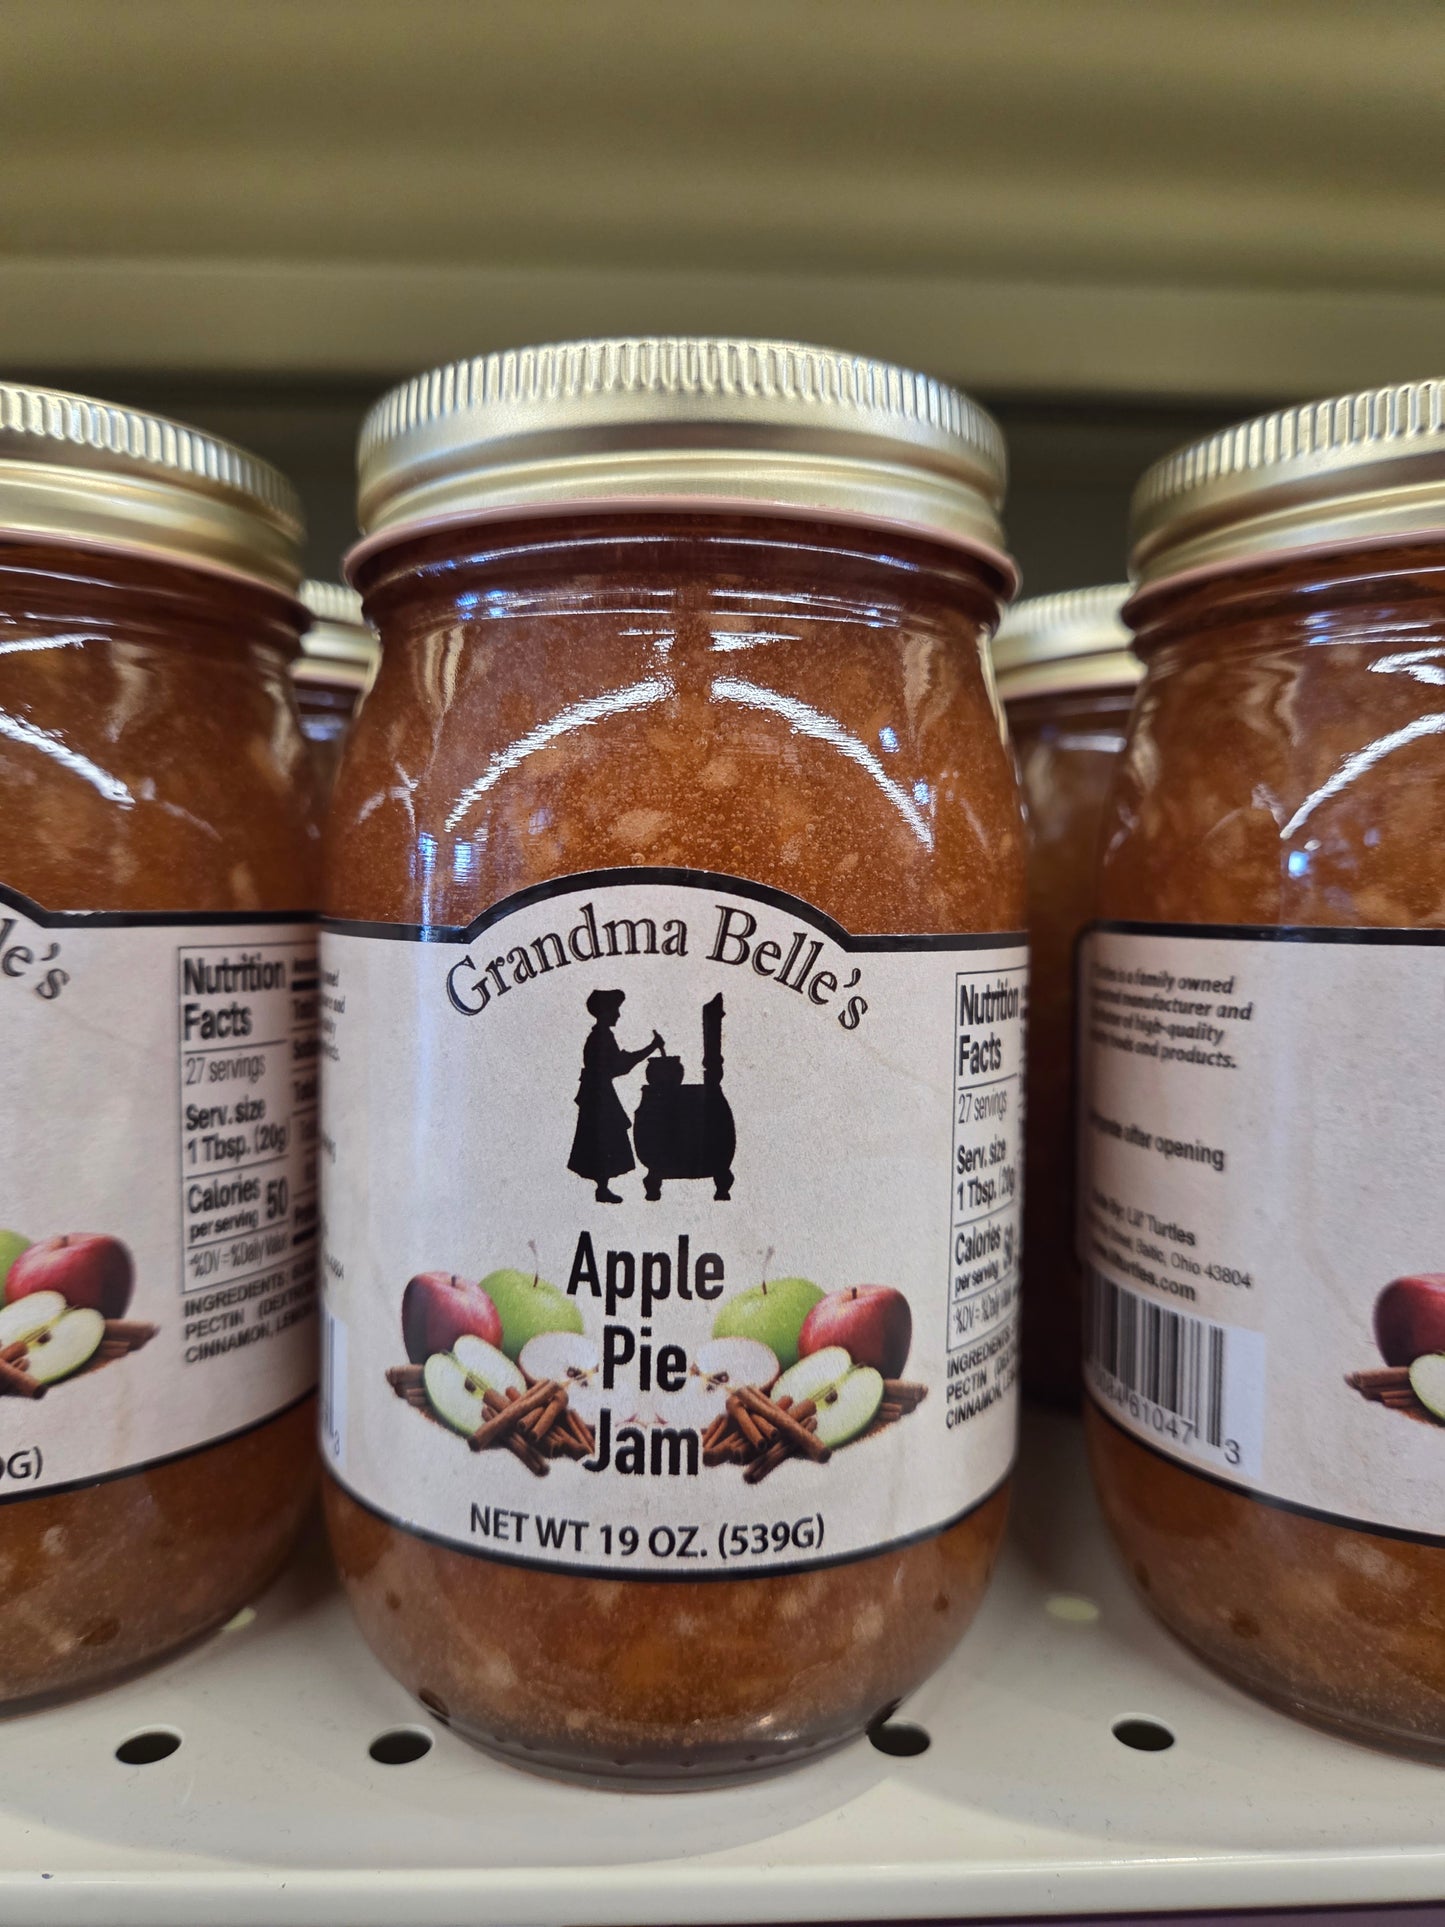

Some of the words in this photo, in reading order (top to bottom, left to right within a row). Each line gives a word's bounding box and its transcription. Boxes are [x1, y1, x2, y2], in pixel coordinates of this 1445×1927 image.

[184, 953, 286, 995] Nutrition
[446, 902, 688, 1016] Grandma
[706, 905, 868, 1030] Belle's
[960, 978, 1018, 1026] Nutrition
[1178, 975, 1235, 994] owned
[184, 1002, 252, 1042] Facts
[1217, 1001, 1253, 1021] and
[185, 1057, 205, 1086] 27
[209, 1054, 266, 1084] servings
[959, 1032, 1002, 1076] Facts
[1161, 1046, 1237, 1069] products.
[186, 1102, 234, 1131] Serv.
[237, 1095, 266, 1124] size
[958, 1093, 972, 1124] 27
[187, 1139, 197, 1164] 1
[203, 1133, 250, 1164] Tbsp.
[957, 1143, 988, 1175] Serv.
[1155, 1138, 1225, 1172] opening
[188, 1173, 260, 1214] Calories
[266, 1176, 288, 1218] 50
[957, 1181, 965, 1211] 1
[190, 1221, 212, 1243] per
[214, 1210, 259, 1233] serving
[955, 1220, 1001, 1265] Calories
[1146, 1212, 1196, 1247] Turtles
[567, 1231, 724, 1317] Apple
[1170, 1251, 1201, 1276] Ohio
[1204, 1260, 1252, 1289] 43804
[185, 1308, 245, 1340] PECTIN
[603, 1325, 687, 1391] Pie
[946, 1367, 987, 1404] PECTIN
[583, 1408, 699, 1476] Jam
[1225, 1438, 1240, 1465] 3
[470, 1502, 529, 1542] NET
[535, 1514, 589, 1551] WT
[601, 1524, 639, 1557] 19
[649, 1525, 707, 1558] OZ.
[718, 1513, 824, 1560] (539G)
